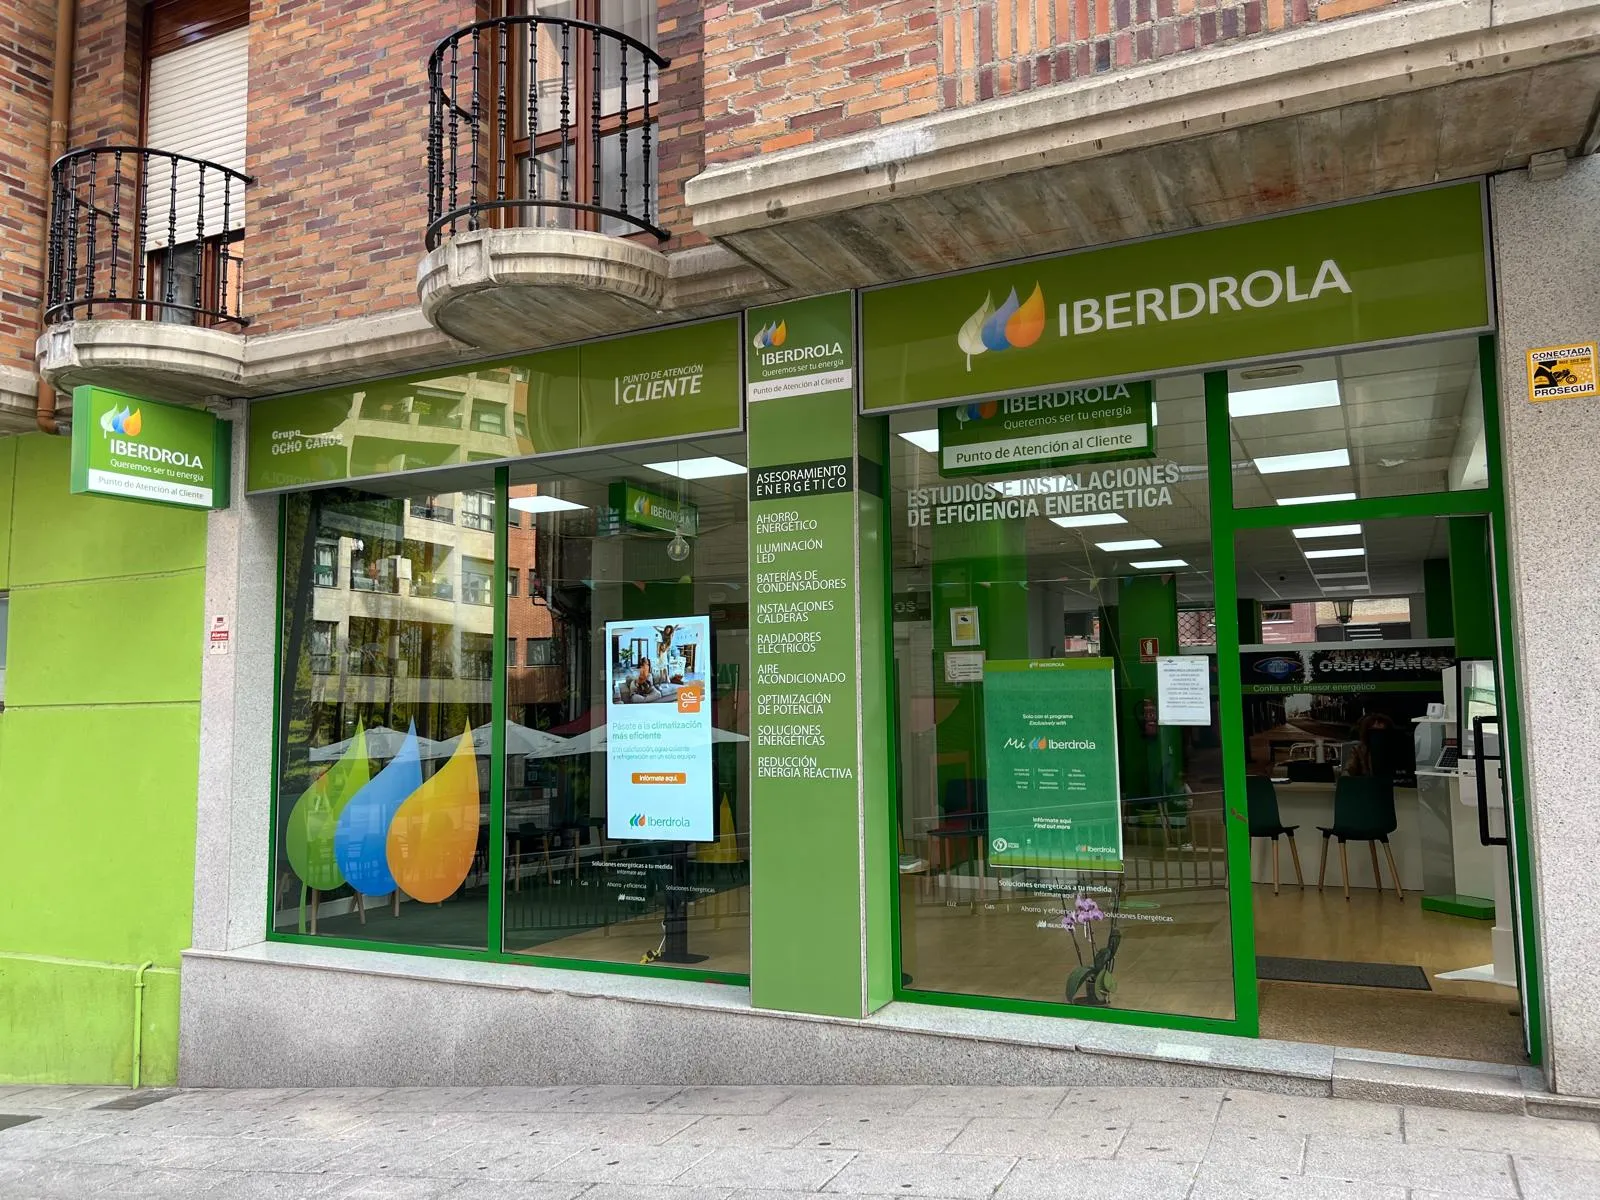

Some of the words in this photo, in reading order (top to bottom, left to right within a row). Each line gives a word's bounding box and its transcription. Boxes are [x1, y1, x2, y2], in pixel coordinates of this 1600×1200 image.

[1058, 258, 1353, 337] IBERDROLA
[761, 342, 843, 366] IBERDROLA
[1532, 347, 1591, 360] CONECTADA
[623, 373, 649, 384] PUNTO
[651, 371, 663, 380] DE
[663, 363, 703, 378] ATENCIÓN
[762, 366, 797, 377] Queremos
[818, 358, 844, 369] energía
[622, 374, 703, 404] CLIENTE
[753, 387, 773, 395] Punto
[783, 381, 812, 391] Atención
[814, 379, 820, 387] al
[820, 376, 844, 385] Cliente
[1534, 384, 1594, 396] PROSEGUR
[1003, 383, 1131, 414] IBERDROLA
[1004, 416, 1057, 430] Queremos
[1059, 414, 1075, 423] ser
[1077, 411, 1089, 421] tu
[1092, 405, 1132, 418] energía
[272, 429, 301, 440] Grupo
[110, 438, 203, 469] IBERDROLA
[271, 440, 302, 455] OCHO
[956, 451, 992, 464] Punto
[994, 447, 1010, 459] de
[1012, 442, 1069, 457] Atención
[1072, 439, 1083, 450] al
[1086, 433, 1133, 449] Cliente
[110, 458, 152, 473] Queremos
[153, 467, 165, 475] ser
[167, 468, 175, 476] tu
[756, 464, 846, 484] ASESORAMIENTO
[98, 475, 122, 487] Punto
[124, 479, 135, 488] de
[171, 486, 177, 495] al
[179, 489, 204, 500] Cliente
[756, 476, 847, 496] ENERGÉTICO
[906, 482, 996, 508] ESTUDIOS
[1002, 481, 1013, 498] E
[1019, 463, 1179, 496] INSTALACIONES
[756, 511, 799, 524] AHORRO
[907, 508, 931, 527] DE
[936, 498, 1039, 525] EFICIENCIA
[756, 519, 818, 534] ENERGÉTICO
[756, 538, 823, 554] ILUMINACIÓN
[756, 553, 776, 564] LED
[756, 570, 802, 584] BATERÍAS
[804, 570, 818, 581] DE
[756, 578, 847, 594] CONDENSADORES
[757, 600, 834, 614] INSTALACIONES
[757, 612, 809, 624] CALDERAS
[757, 632, 822, 644] RADIADORES
[757, 643, 816, 654] ELÉCTRICOS
[757, 664, 779, 674] AIRE
[1319, 656, 1375, 673] OCHO
[757, 672, 846, 684] ACONDICIONADO
[757, 692, 831, 705] OPTIMIZACIÓN
[757, 705, 771, 715] DE
[773, 704, 824, 715] POTENCIA
[643, 721, 650, 729] la
[651, 720, 702, 730] climatización
[757, 725, 821, 736] SOLUCIONES
[612, 732, 628, 740] más
[629, 731, 662, 740] eficiente
[757, 735, 826, 746] ENERGÉTICAS
[1003, 737, 1026, 749] Mi
[1048, 739, 1096, 750] Iberdrola
[758, 755, 817, 767] REDUCCIÓN
[803, 768, 853, 779] REACTIVA
[647, 816, 690, 827] Iberdrola
[1087, 846, 1116, 854] Iberdrola
[617, 862, 644, 870] energéticas
[689, 886, 715, 894] Energéticas
[999, 880, 1033, 889] Soluciones
[1034, 882, 1072, 892] energéticas
[1086, 885, 1112, 893] medida
[1020, 905, 1041, 914] Ahorro
[1104, 911, 1136, 920] Soluciones
[1137, 912, 1173, 922] Energéticas
